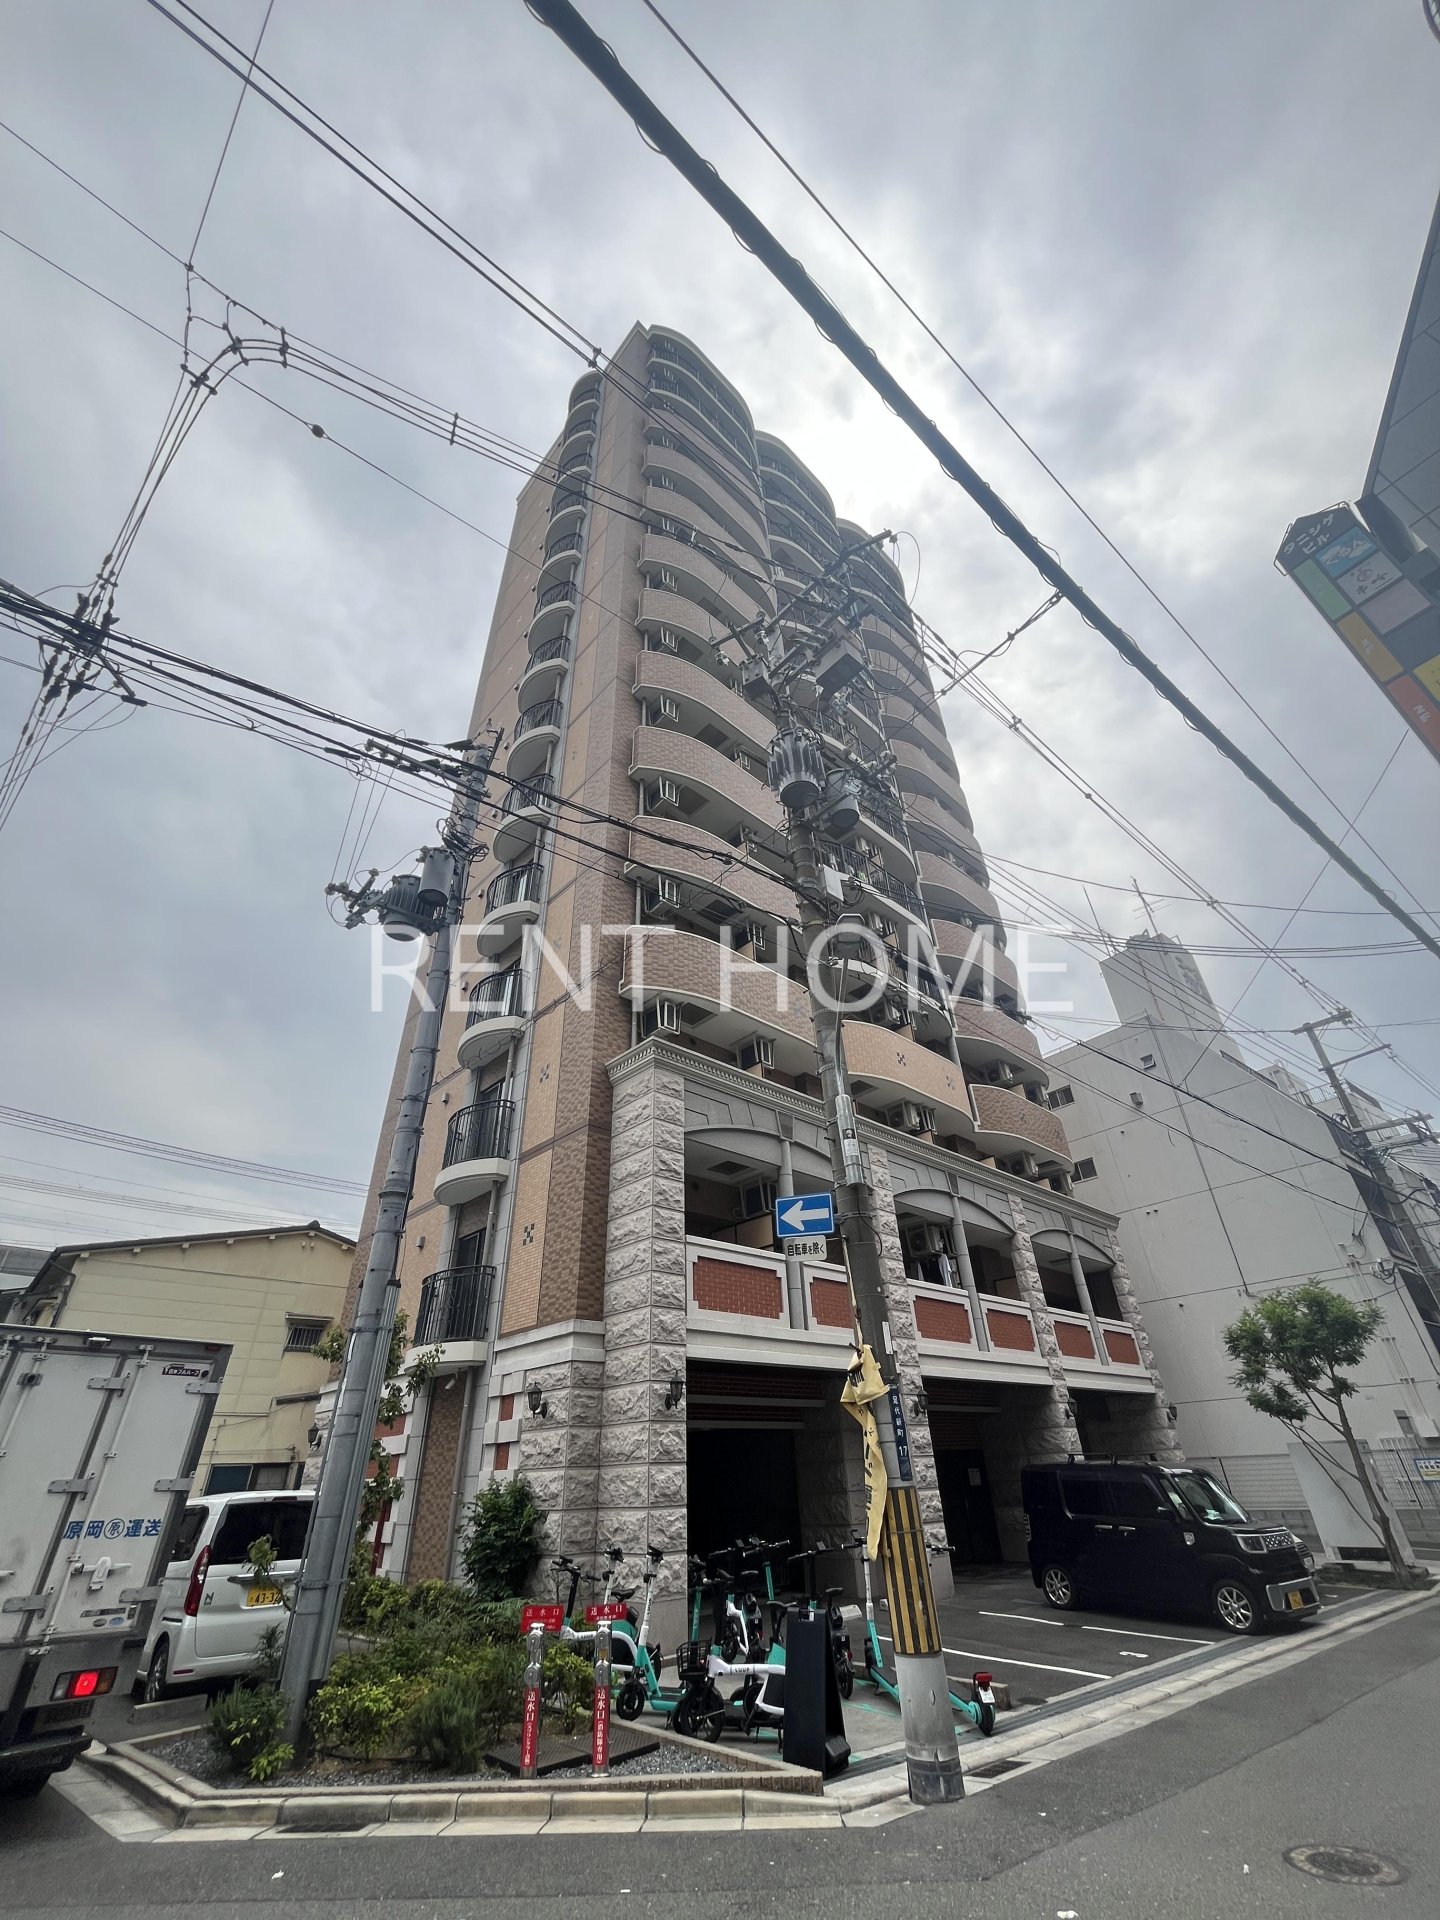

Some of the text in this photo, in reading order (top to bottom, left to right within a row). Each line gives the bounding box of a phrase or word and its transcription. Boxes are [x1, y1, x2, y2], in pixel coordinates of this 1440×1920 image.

[787, 1242, 826, 1261] 自転車を除く
[891, 1395, 904, 1438] 足代新町
[898, 1445, 908, 1457] 17
